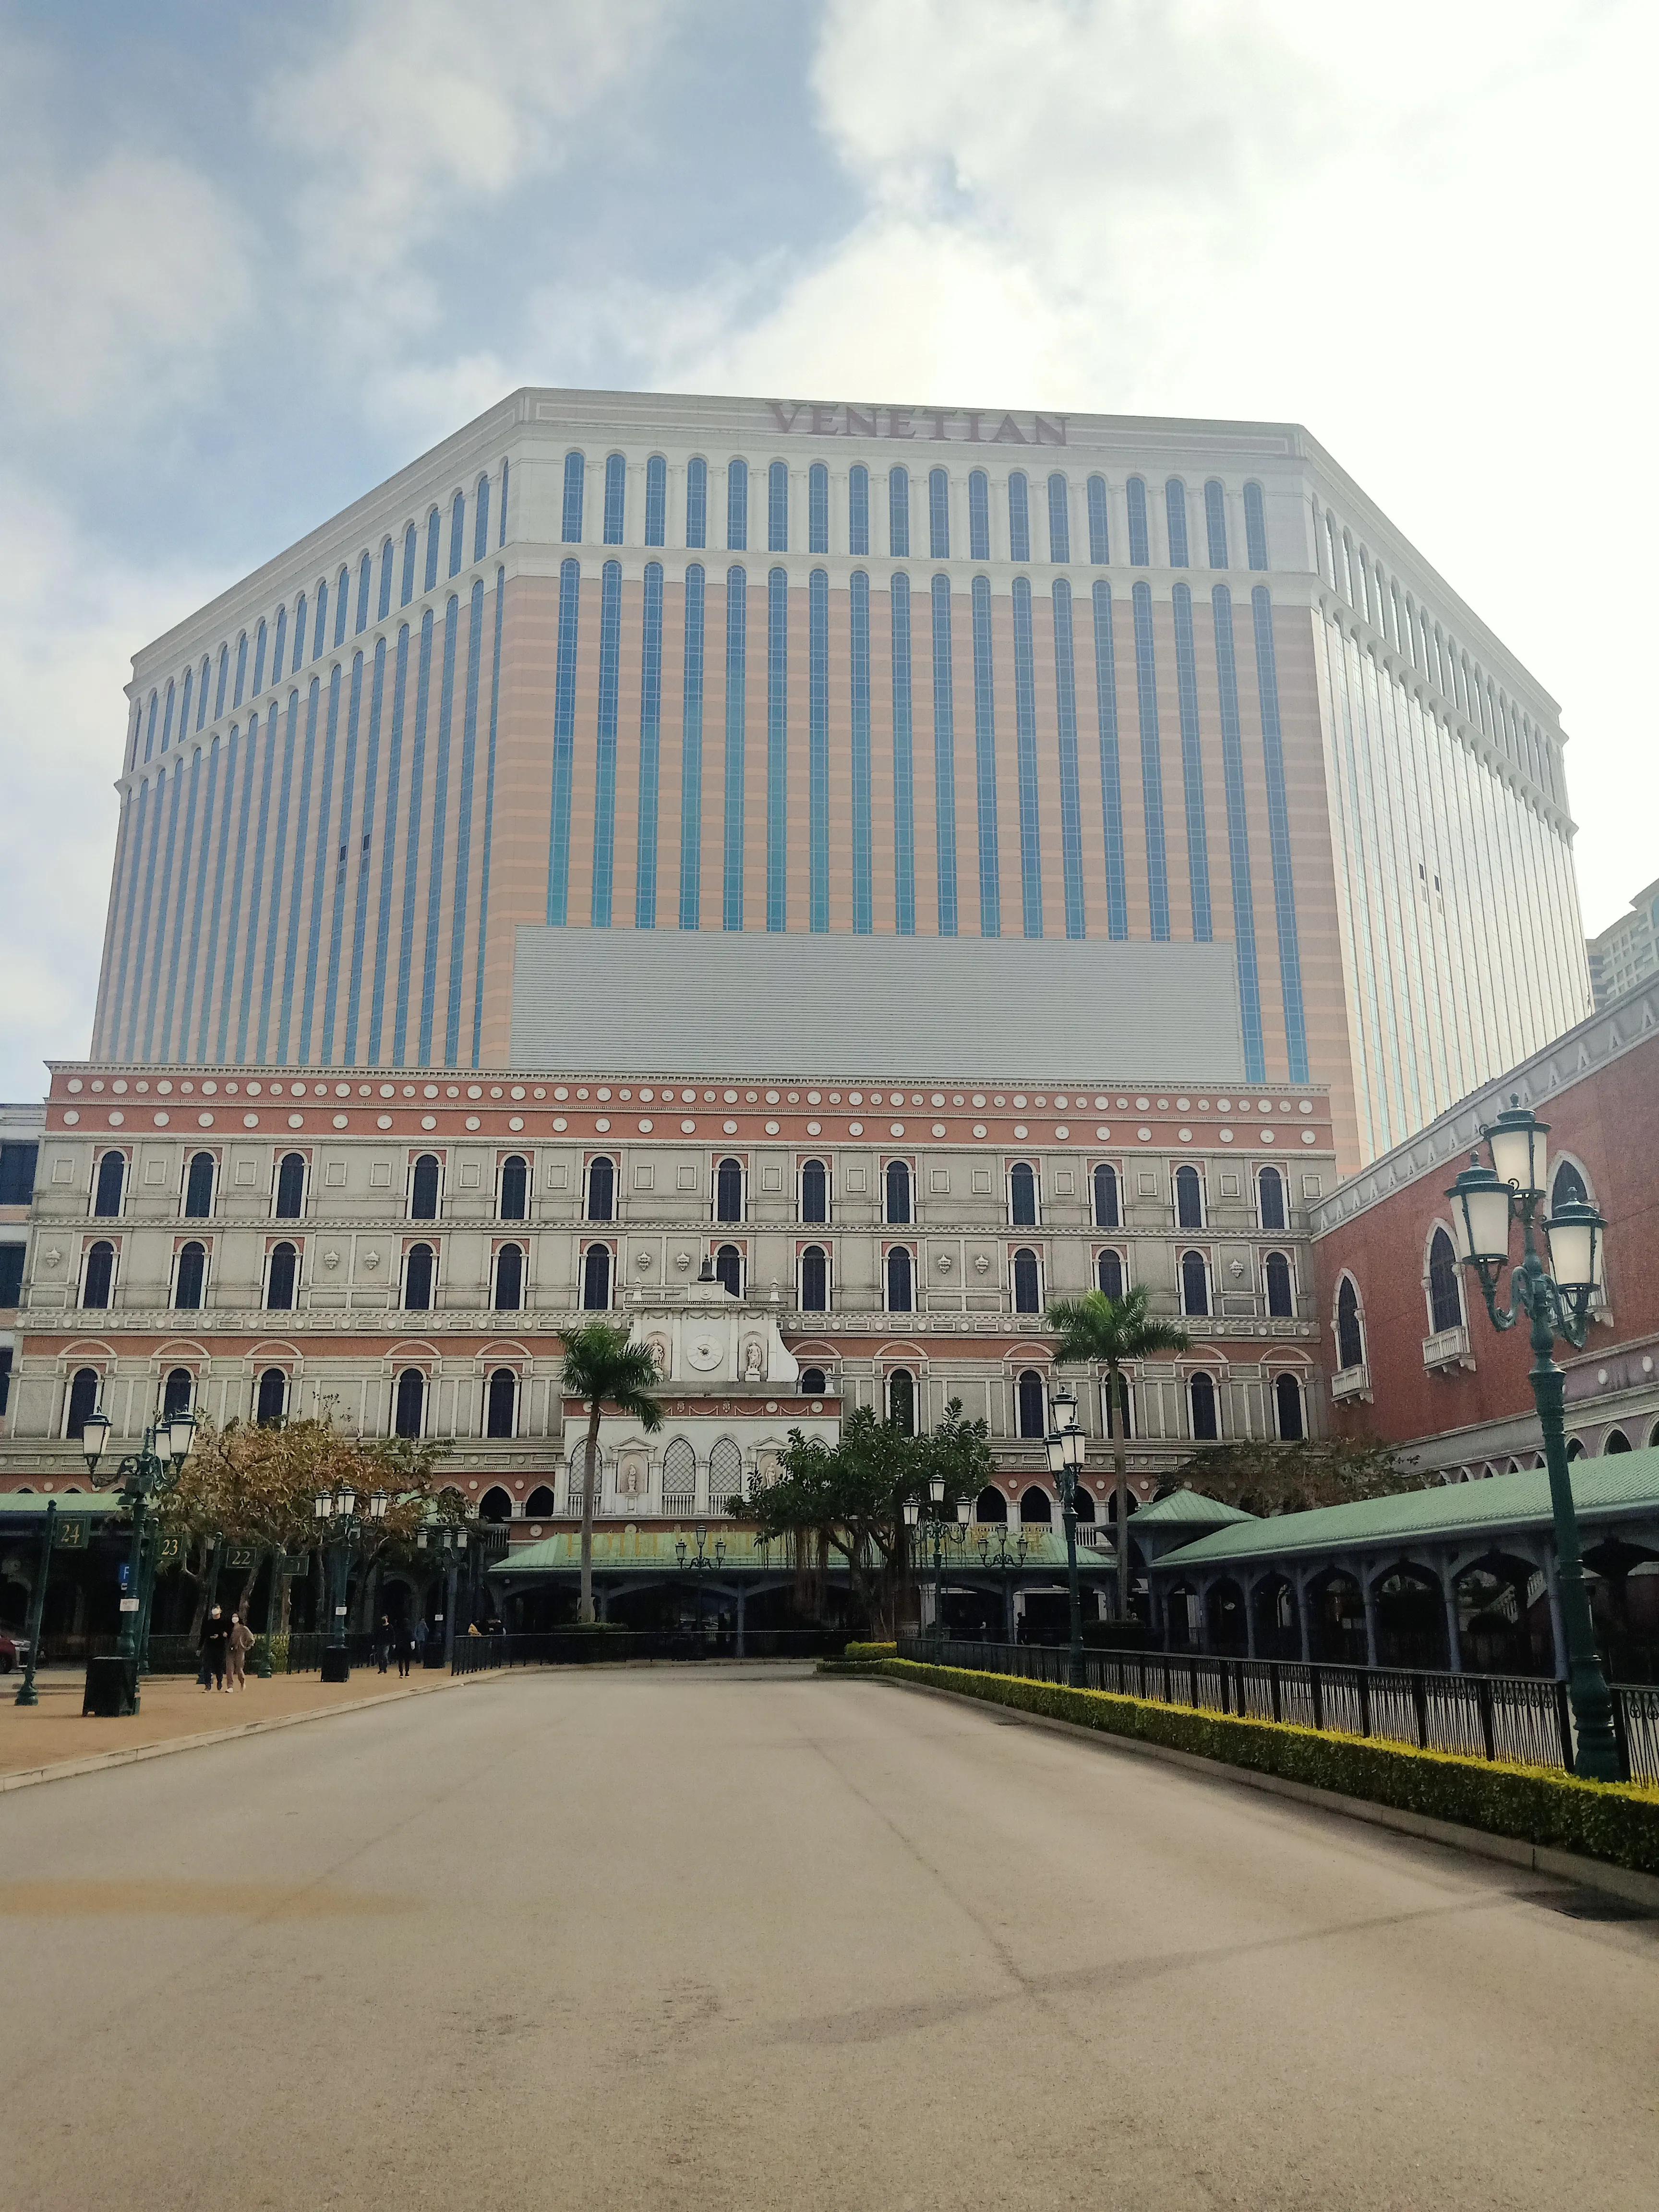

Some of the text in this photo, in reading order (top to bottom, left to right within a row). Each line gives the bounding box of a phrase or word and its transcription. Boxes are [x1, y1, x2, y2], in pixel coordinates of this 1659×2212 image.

[765, 402, 1070, 446] VENETIAN
[61, 1524, 80, 1544] 24
[161, 1539, 178, 1555] 23
[232, 1551, 250, 1564] 22
